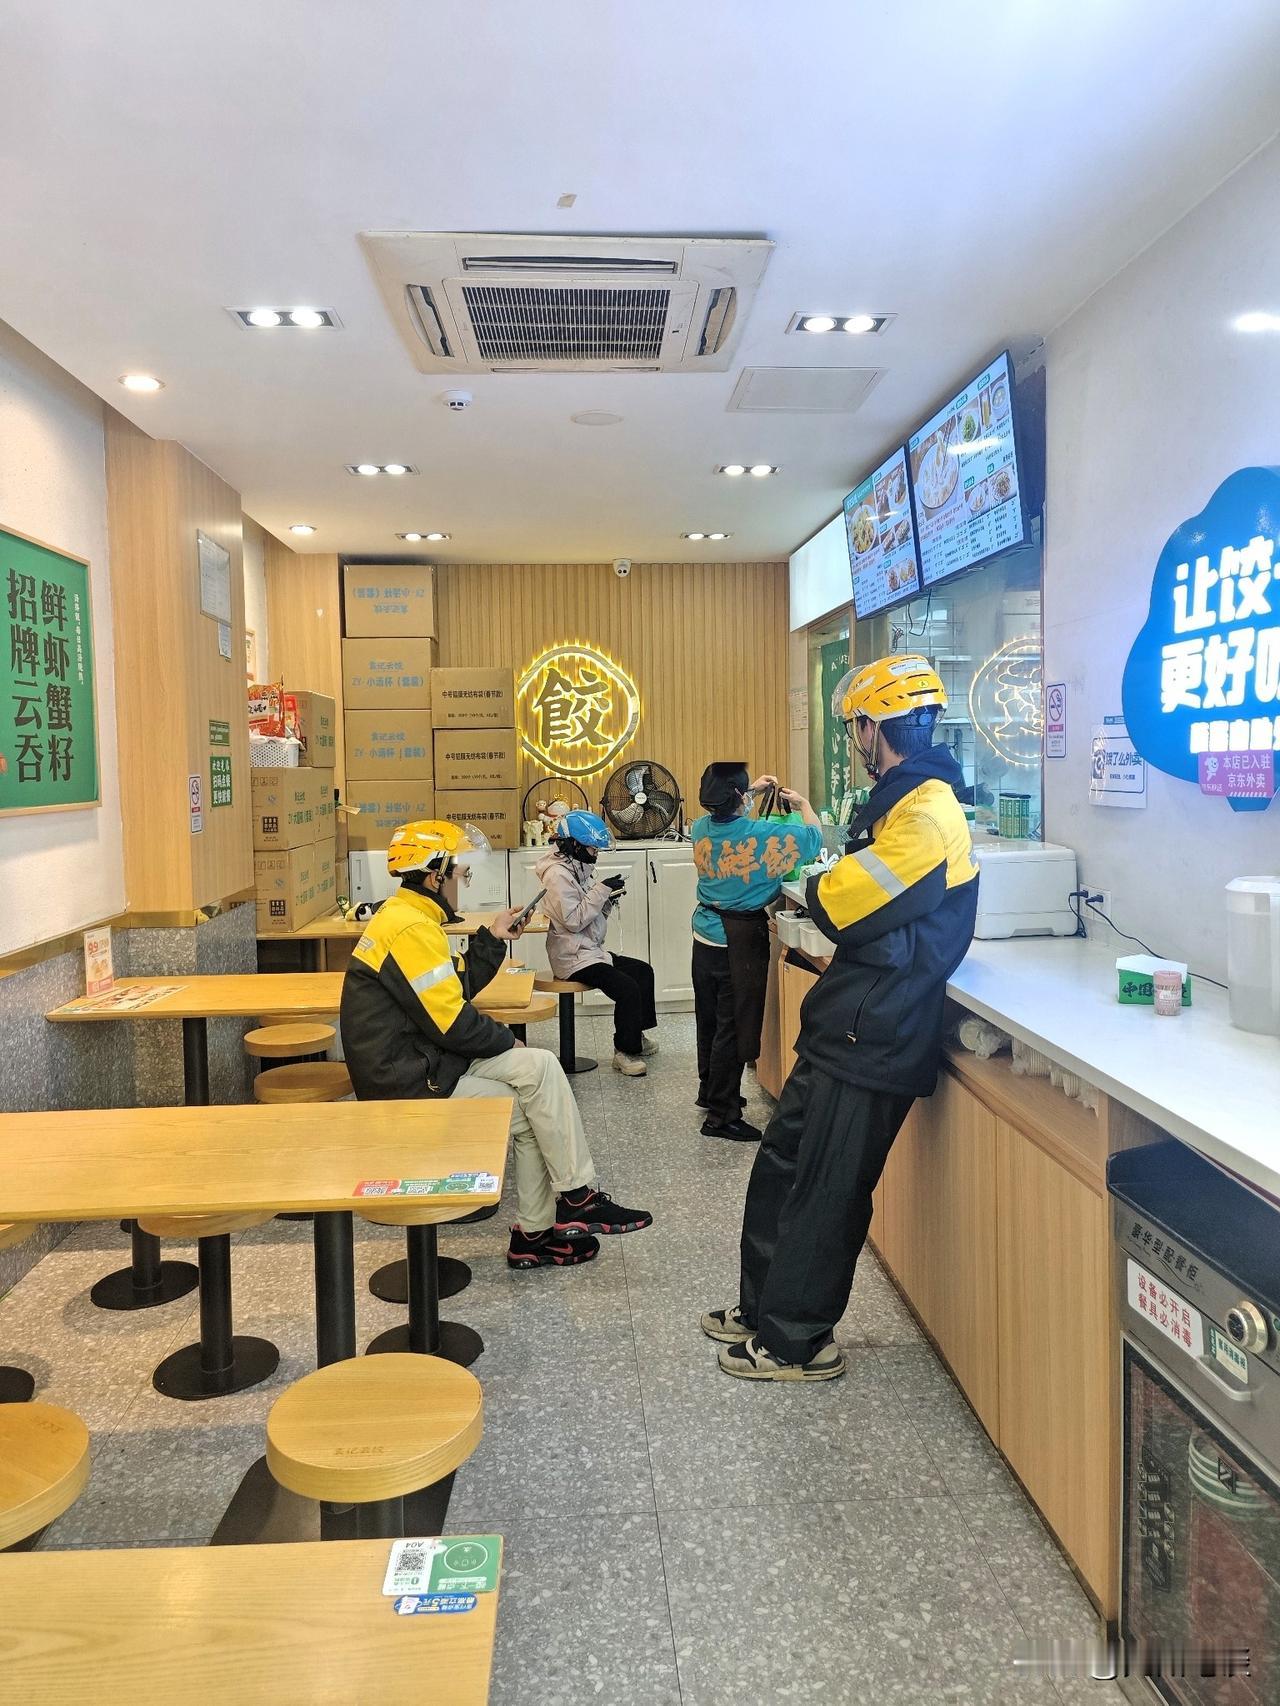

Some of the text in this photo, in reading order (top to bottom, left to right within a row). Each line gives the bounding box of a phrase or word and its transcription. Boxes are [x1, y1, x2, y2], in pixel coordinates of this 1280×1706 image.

[1173, 535, 1280, 634] 让饺
[6, 567, 45, 783] 招牌云吞
[40, 579, 74, 783] 鲜虾蟹籽
[1223, 754, 1271, 769] 本店已入驻
[1227, 773, 1266, 788] 京东外卖
[1138, 1273, 1191, 1328] 设备必开启
[1138, 1293, 1192, 1347] 餐具必消毒
[405, 1541, 425, 1549] A04
